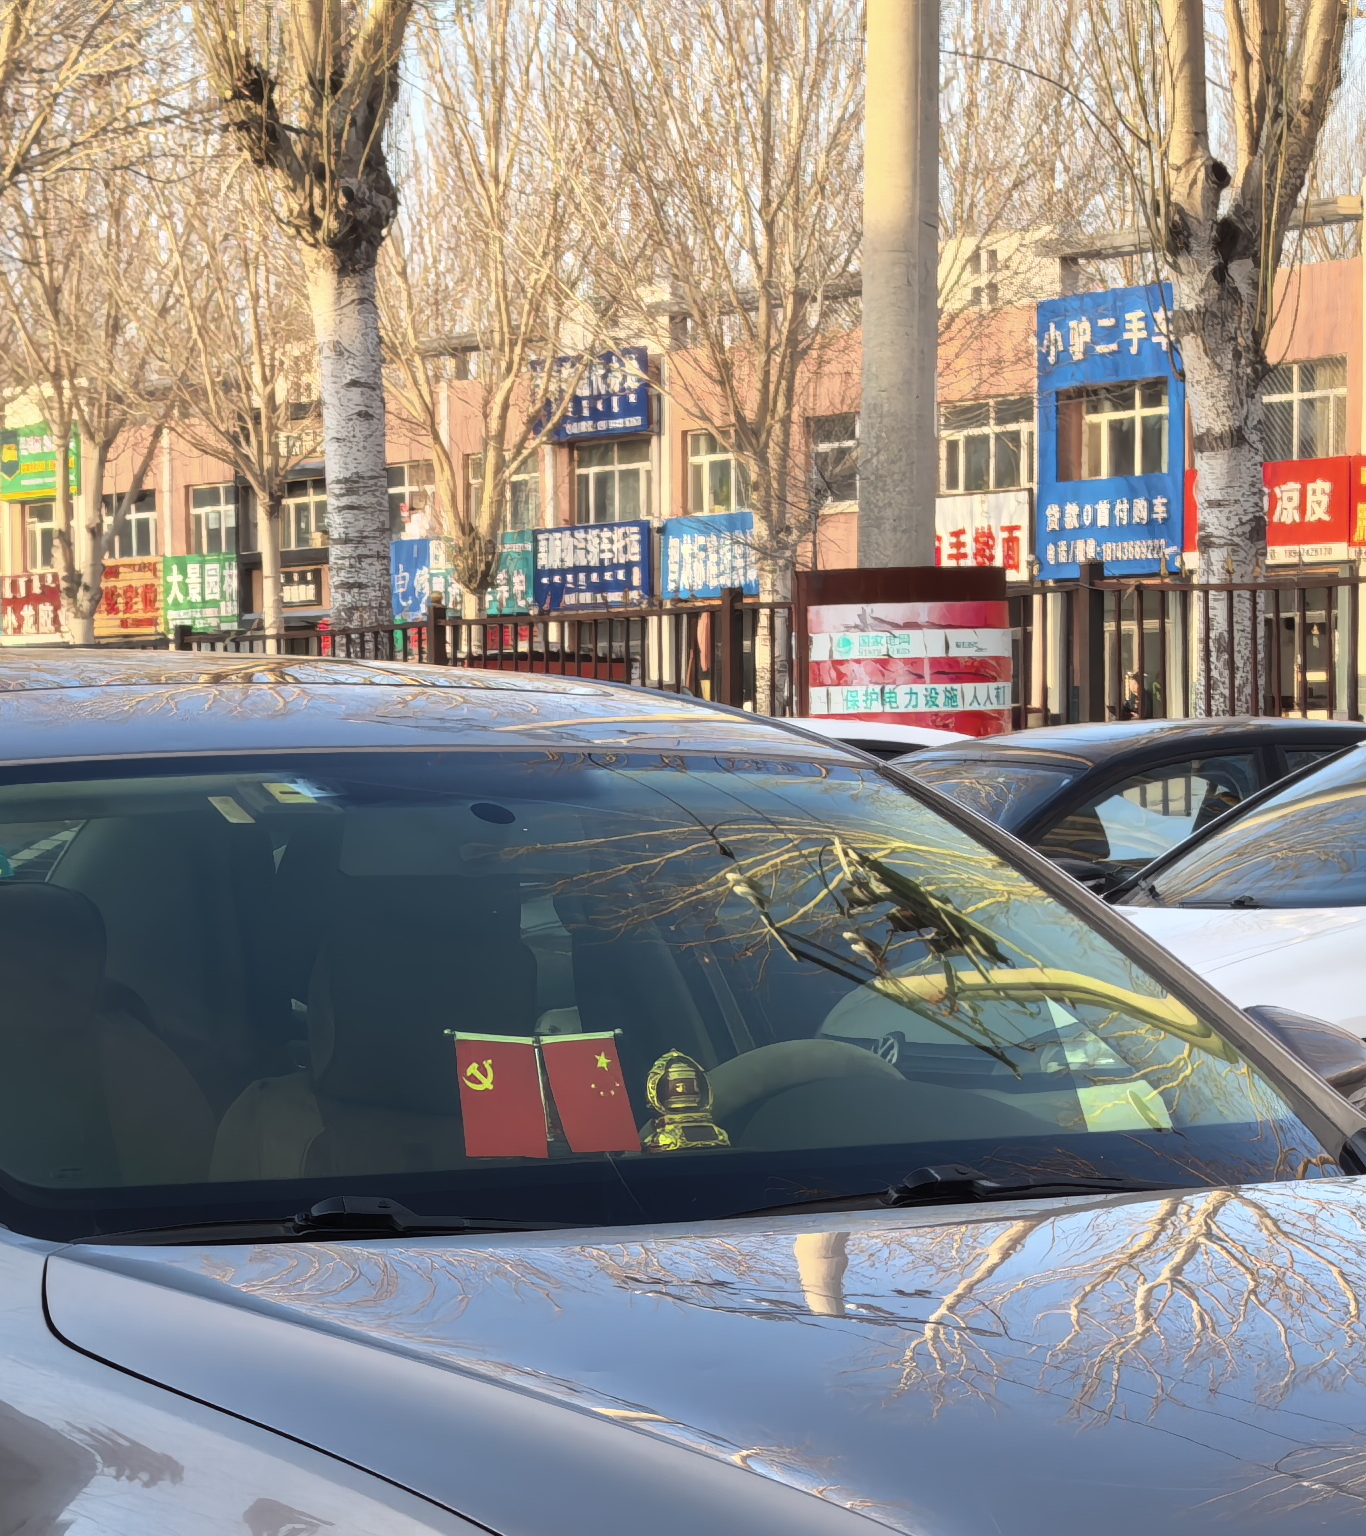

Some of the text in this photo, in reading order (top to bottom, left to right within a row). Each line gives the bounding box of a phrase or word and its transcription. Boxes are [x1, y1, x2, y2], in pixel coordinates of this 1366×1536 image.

[1263, 478, 1333, 524] 凉皮
[858, 633, 910, 648] 国家电网
[844, 686, 960, 710] 保护电力设施
